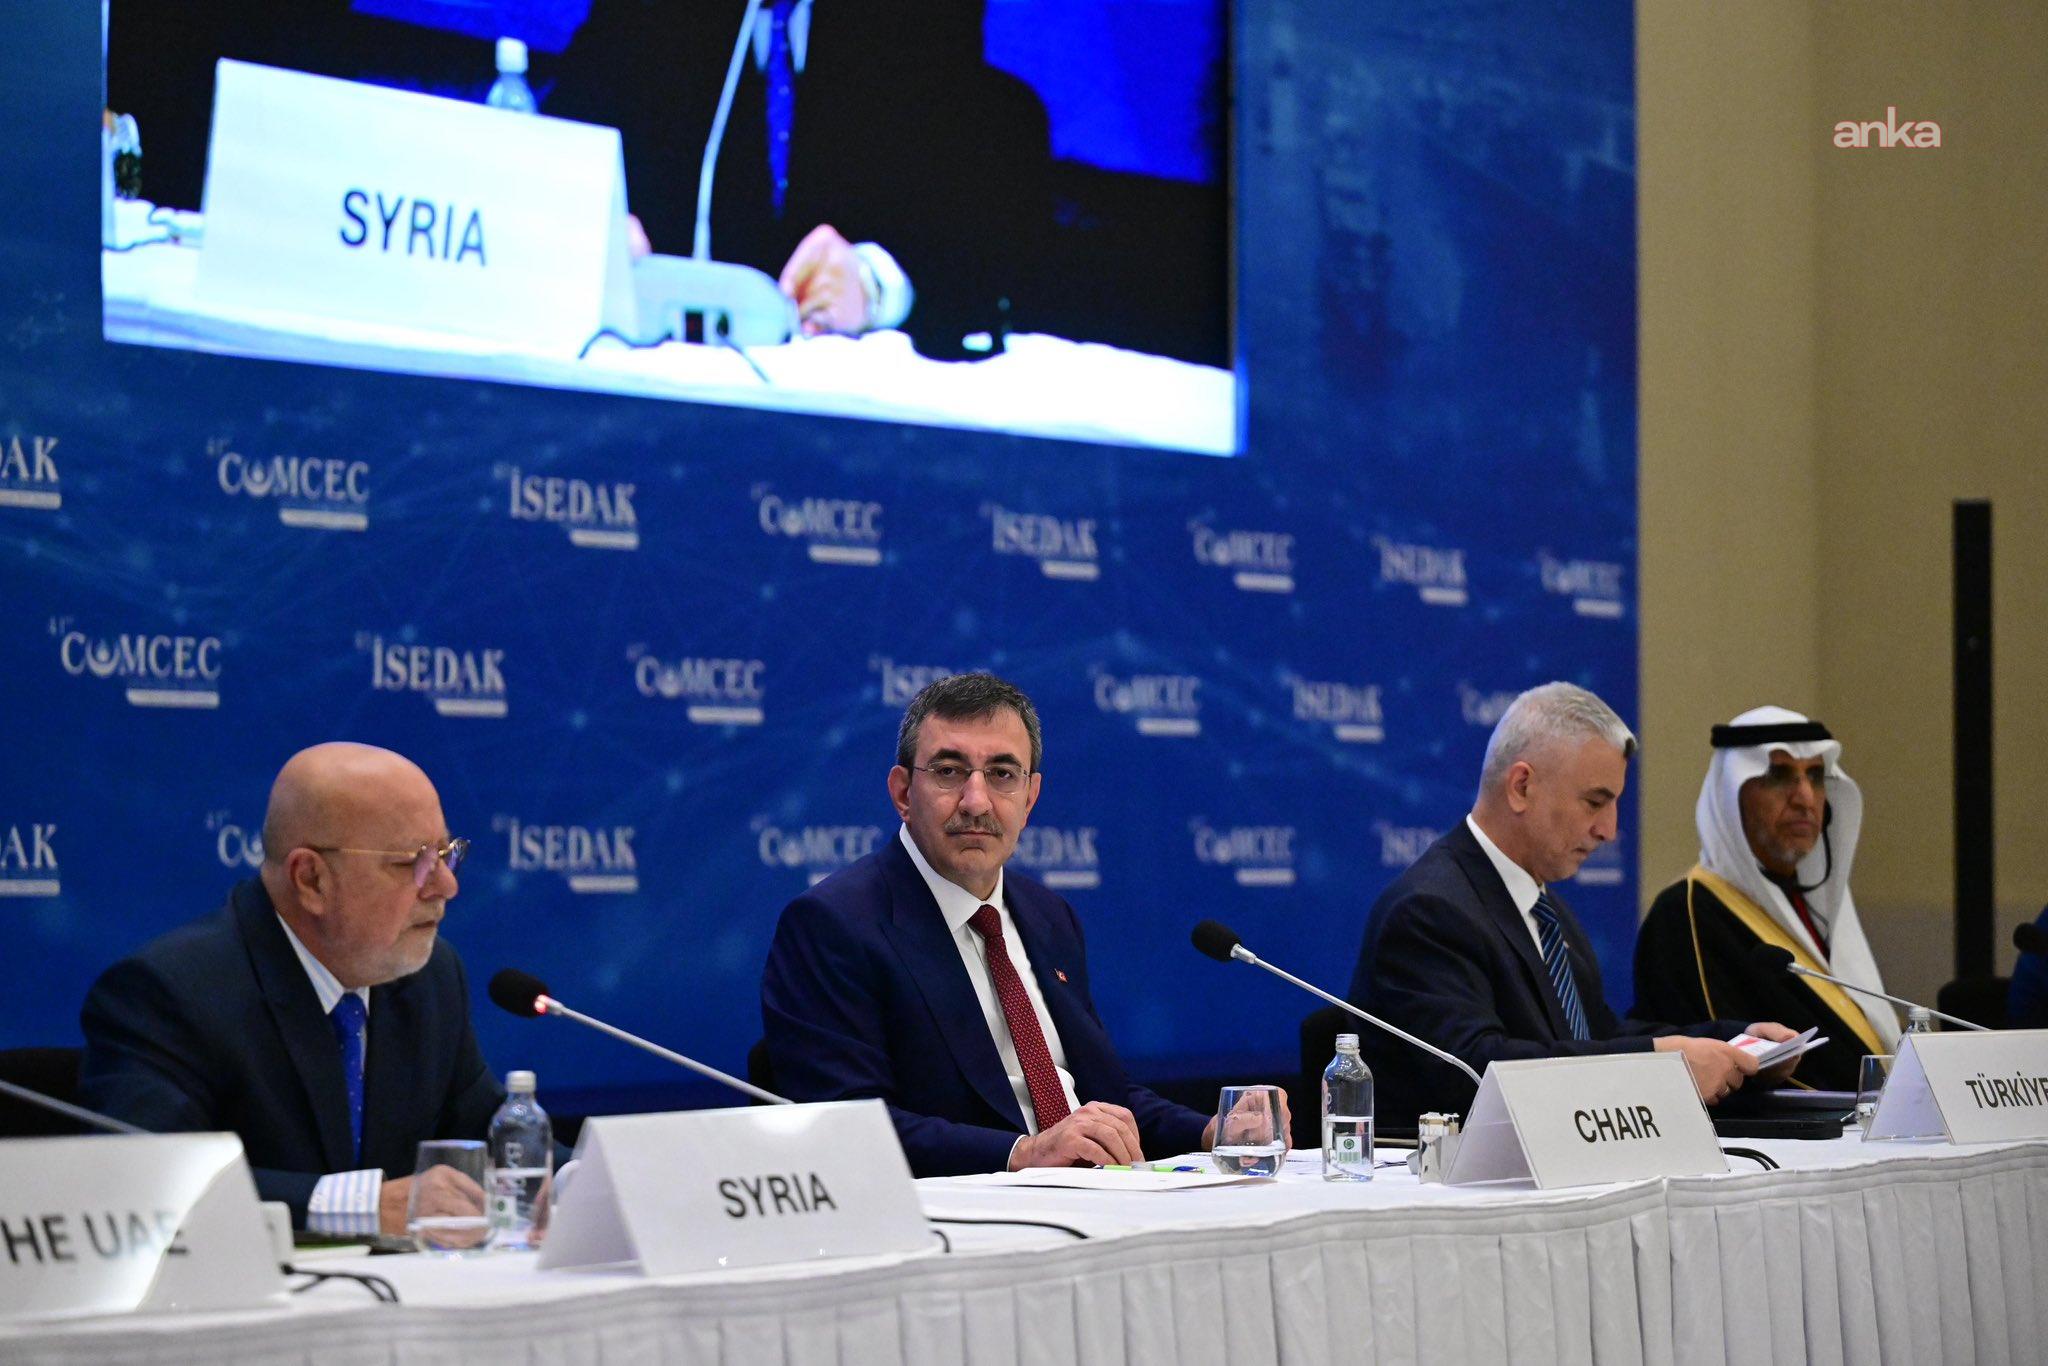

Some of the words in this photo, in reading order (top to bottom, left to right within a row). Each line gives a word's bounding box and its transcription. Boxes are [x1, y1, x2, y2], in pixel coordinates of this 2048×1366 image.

[340, 188, 487, 268] SYRIA
[0, 434, 59, 482] AK
[217, 452, 370, 502] COMCEC
[61, 631, 222, 679] COMCEC
[0, 823, 58, 870] AK
[1574, 1105, 1661, 1143] CHAIR
[718, 1171, 838, 1219] SYRIA
[82, 1208, 189, 1262] UAE
